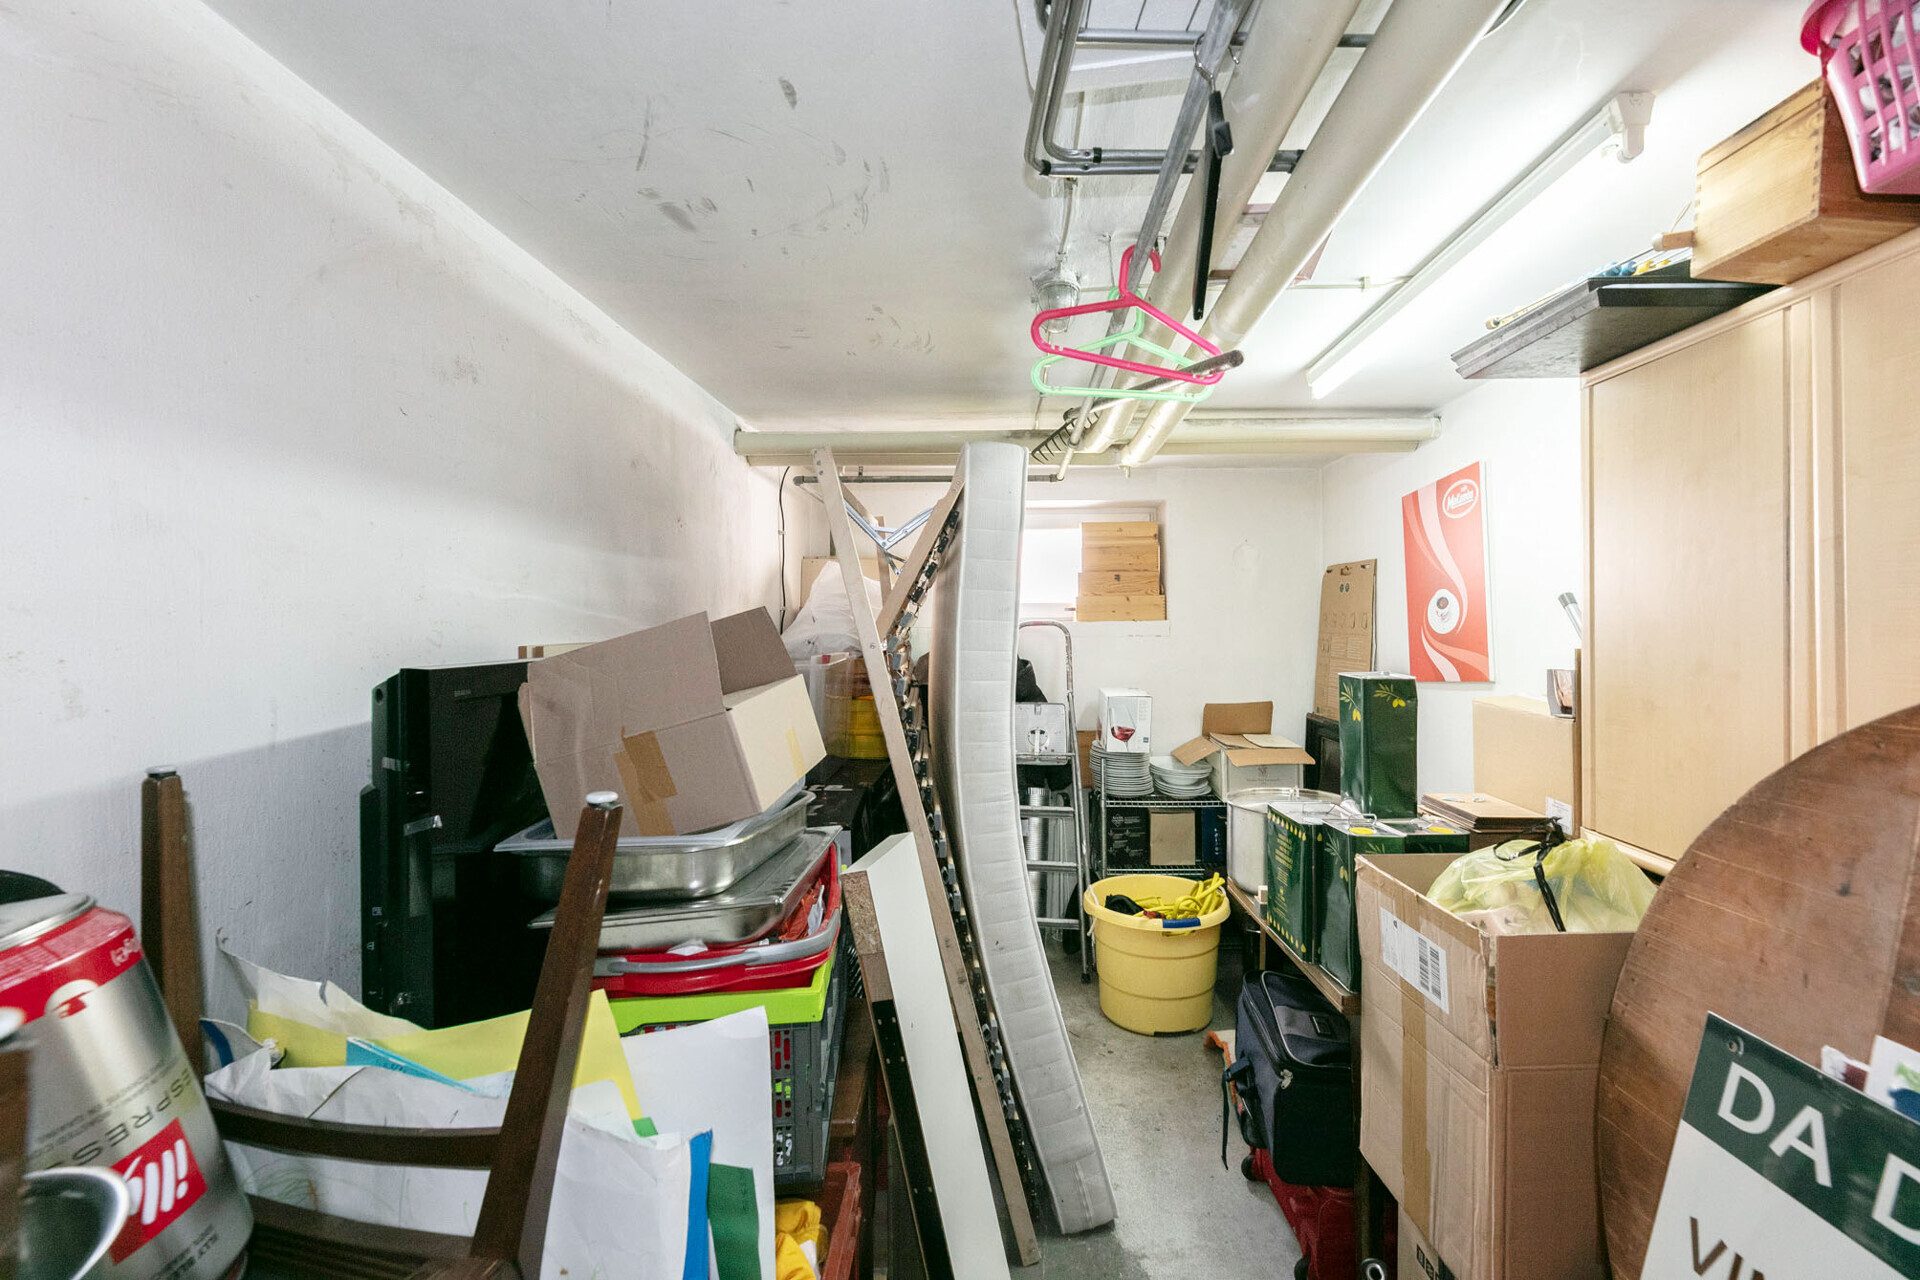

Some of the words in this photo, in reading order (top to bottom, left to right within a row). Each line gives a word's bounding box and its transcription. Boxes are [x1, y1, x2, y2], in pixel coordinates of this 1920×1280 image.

[46, 1067, 194, 1169] ESPRES
[1717, 1062, 1832, 1187] DA
[1690, 1216, 1766, 1280] VI
